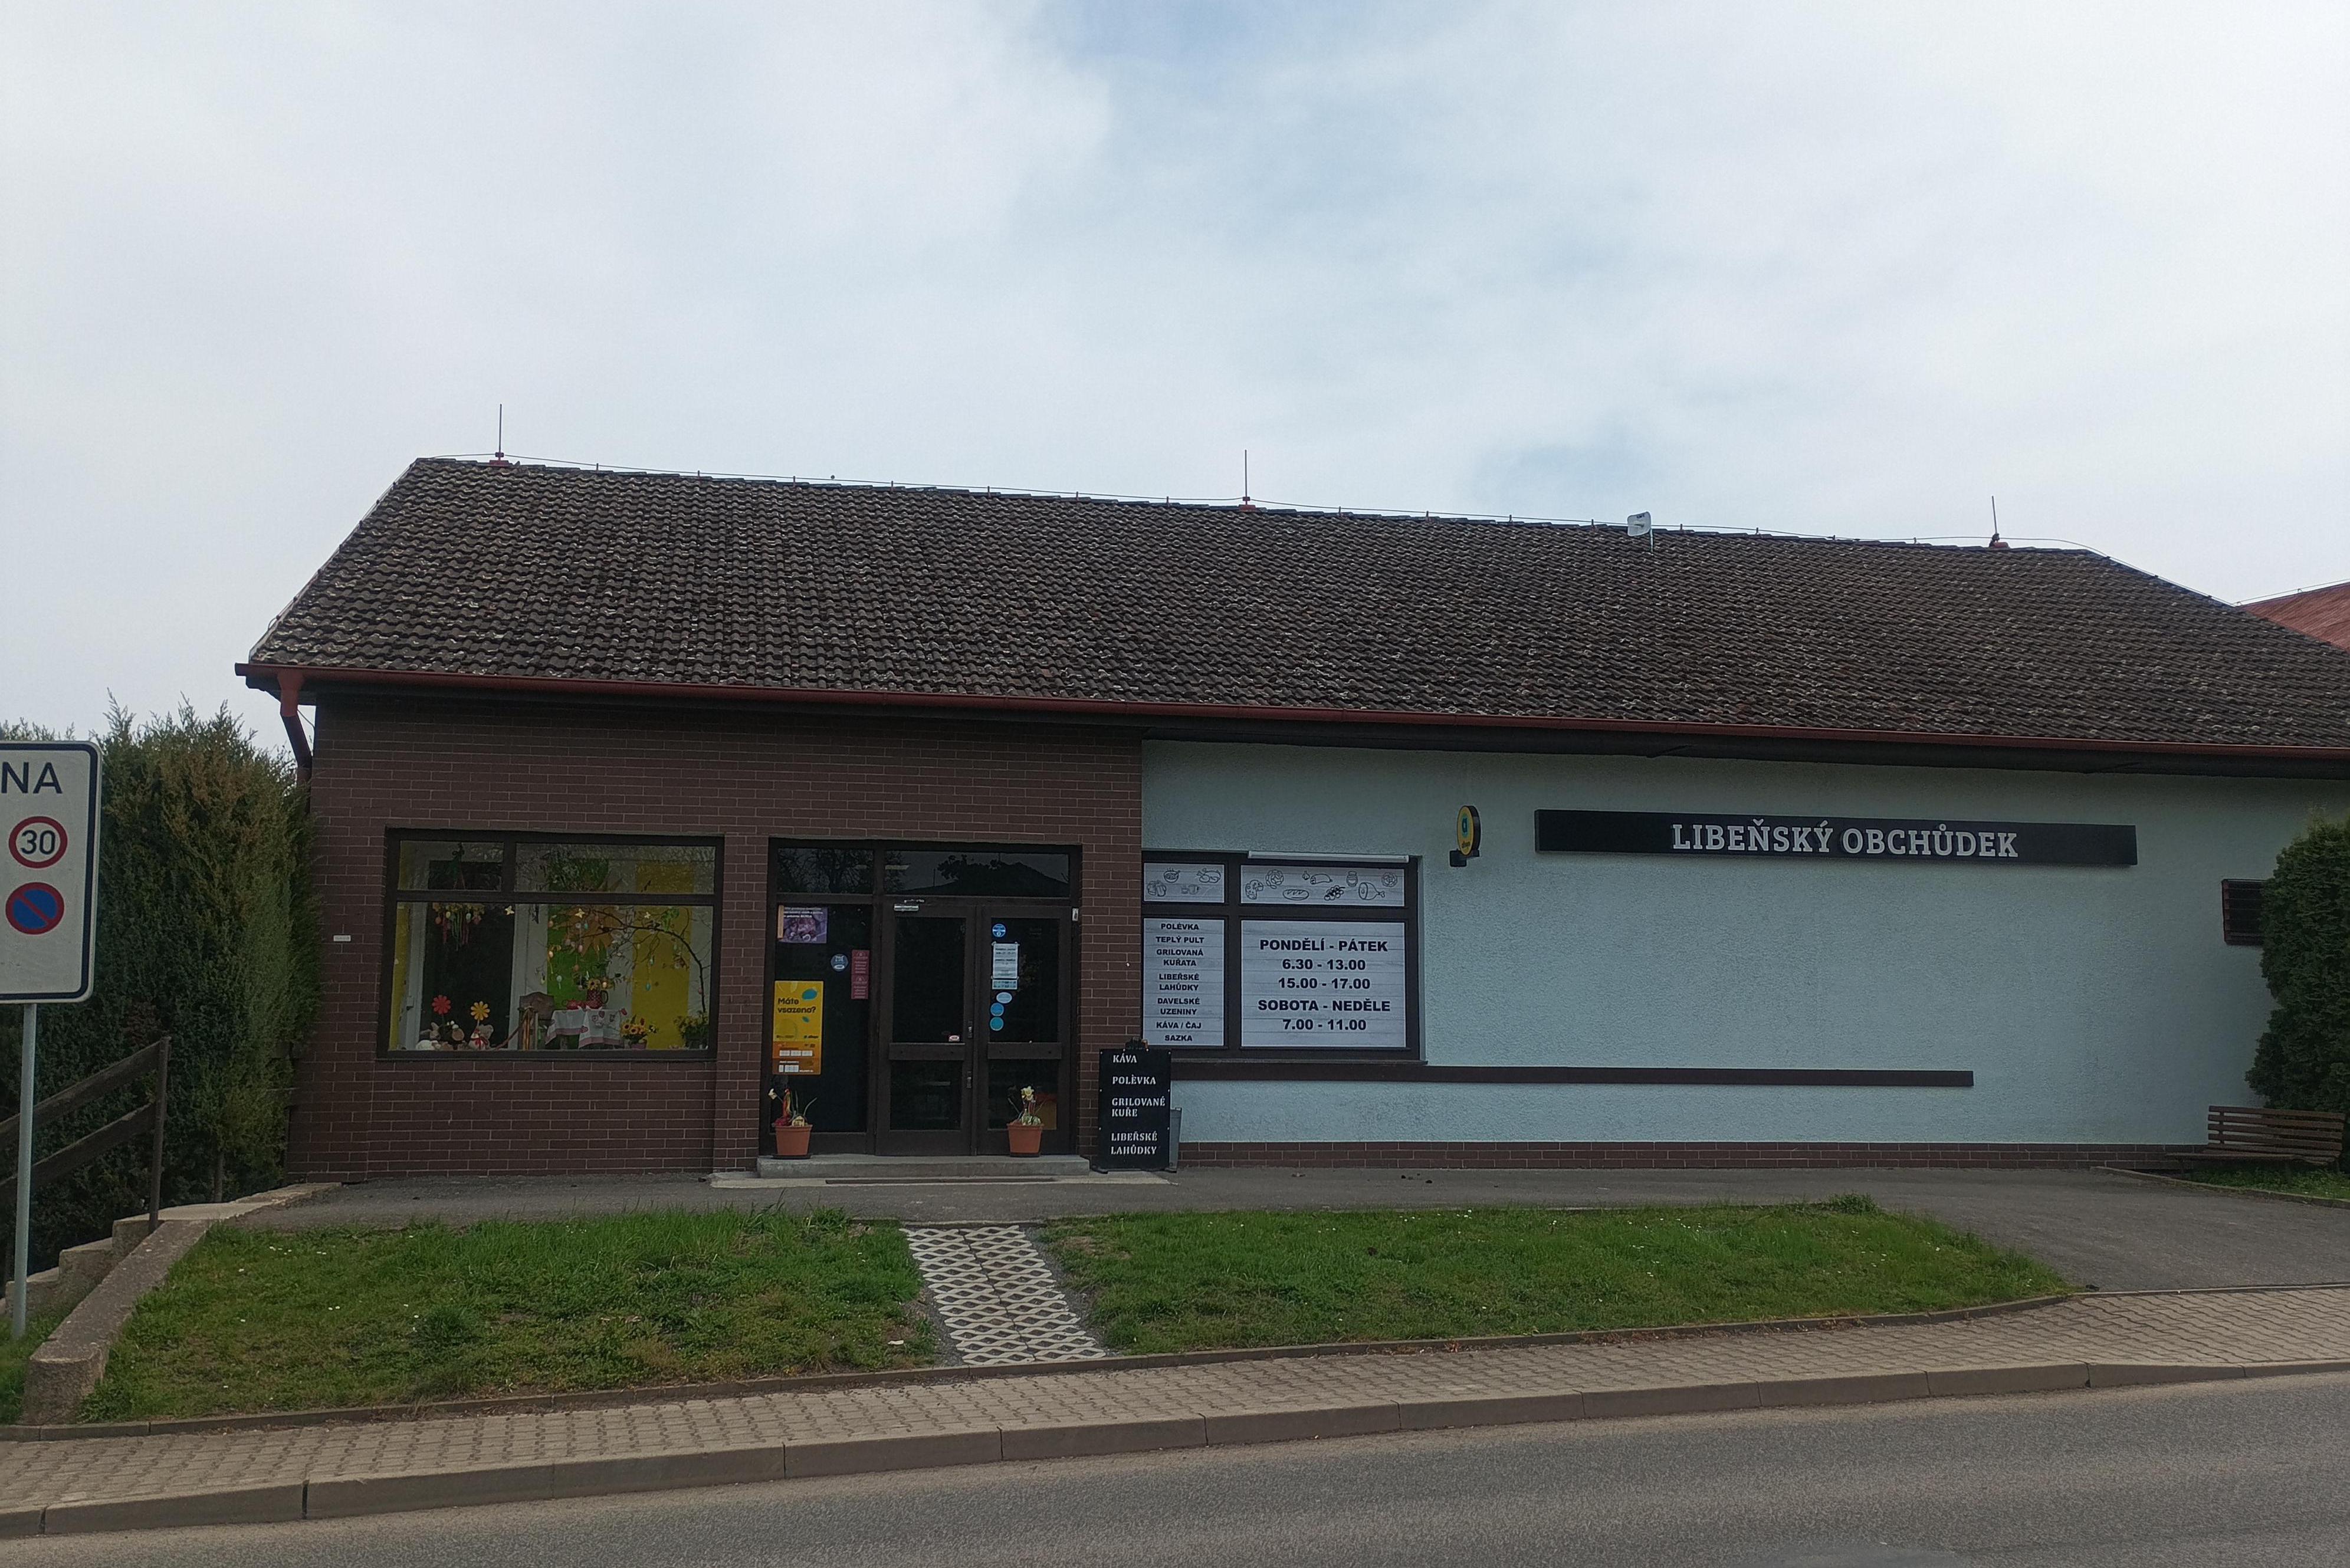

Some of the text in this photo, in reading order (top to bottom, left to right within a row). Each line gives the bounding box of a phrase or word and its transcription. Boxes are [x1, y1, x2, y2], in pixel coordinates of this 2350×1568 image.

[21, 830, 55, 854] 30
[1672, 819, 2018, 857] LIBEŇSKÝ OBCHŮDEK
[1260, 938, 1324, 951] PONDĚLÍ
[1338, 939, 1388, 951] PÁTEK
[1282, 959, 1313, 969] 6.30
[1327, 959, 1366, 970] 13.00
[1279, 978, 1317, 988] 15.00
[1331, 978, 1370, 989] 17.00
[1258, 1000, 1318, 1011] SOBOTA
[1332, 998, 1390, 1011] NEDĚLE
[1283, 1019, 1313, 1030] 7.00
[1327, 1020, 1366, 1030] 11.00
[1113, 1053, 1137, 1063] KÁVA
[1112, 1096, 1165, 1106] GRILOVANÉ
[1112, 1107, 1137, 1117] KUŘE
[1111, 1130, 1157, 1141] LIBEŘSKÉ
